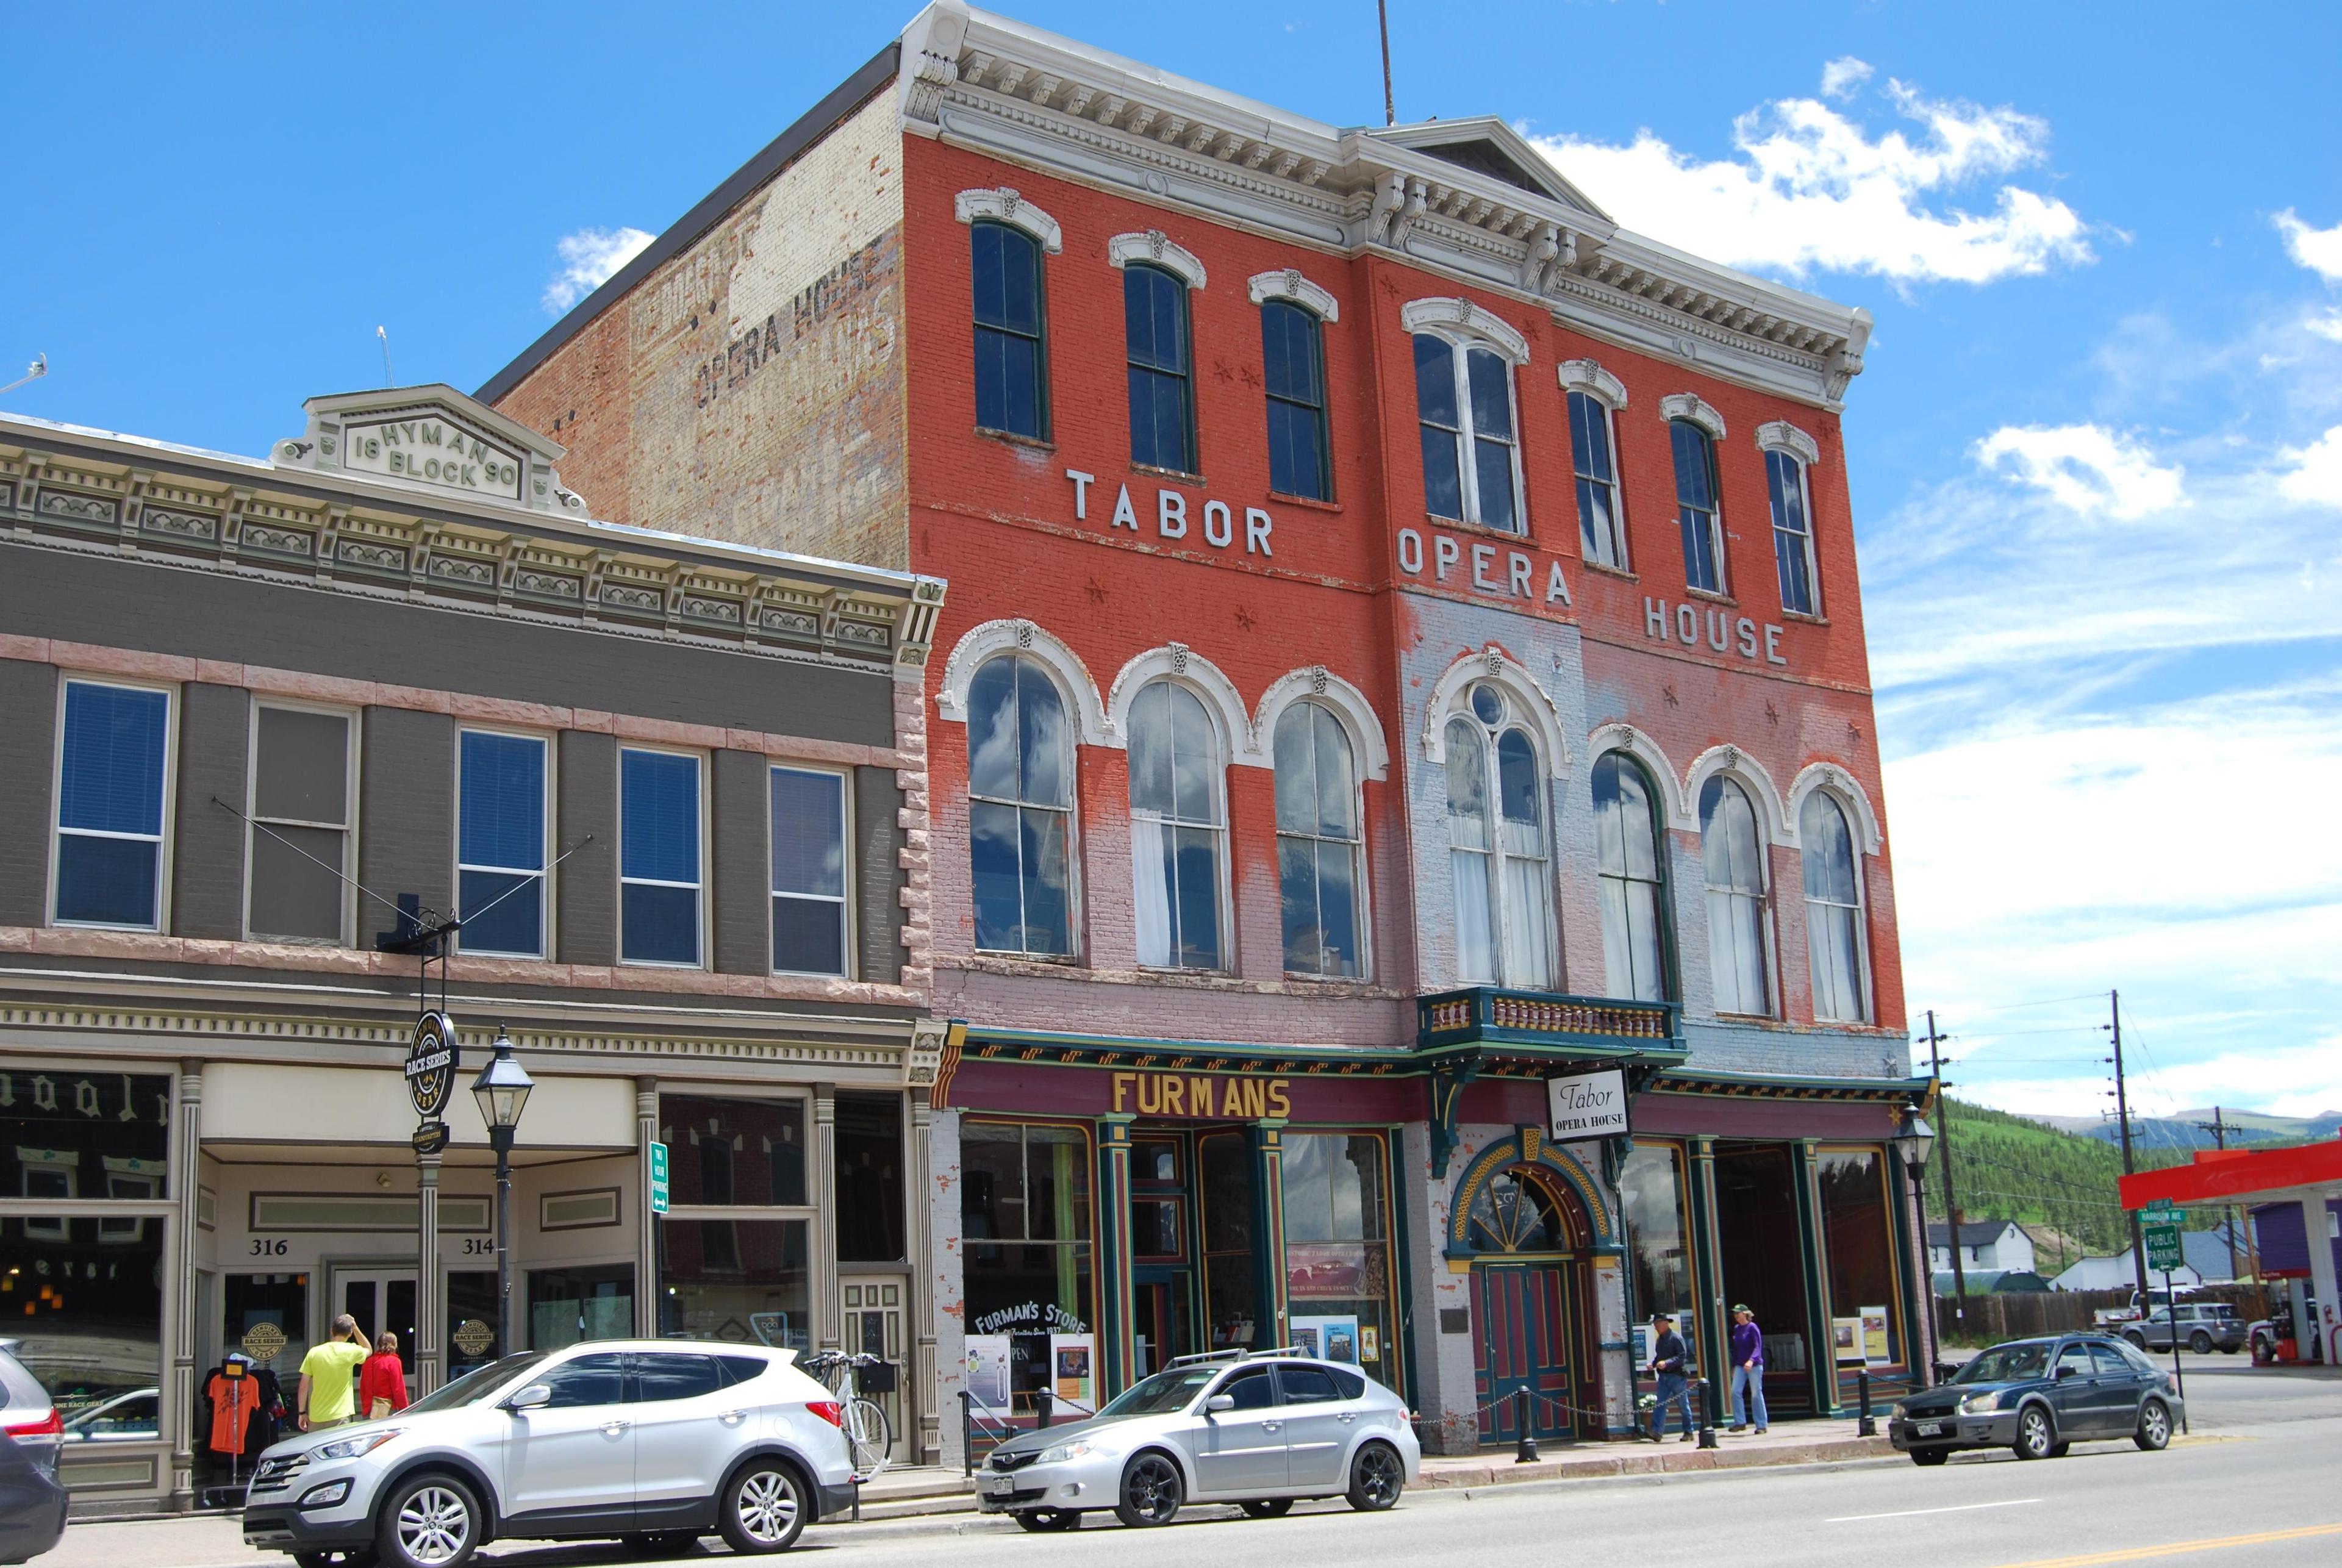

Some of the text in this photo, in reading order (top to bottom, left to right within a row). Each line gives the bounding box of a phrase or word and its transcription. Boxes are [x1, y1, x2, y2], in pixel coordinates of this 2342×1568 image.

[356, 435, 380, 459] 18
[381, 422, 489, 464] HYMAN
[389, 450, 476, 487] BLOCK
[485, 461, 517, 485] 90
[1065, 468, 1787, 665] TABOR OPERA HOUSE
[406, 1049, 451, 1076] RACE SERIES
[417, 1087, 439, 1108] GEAR
[1112, 1072, 1291, 1118] FURMANS
[1560, 1083, 1613, 1110] Tabor
[1555, 1114, 1624, 1131] OPERA HOUSE
[654, 1148, 663, 1161] TWO
[654, 1164, 665, 1177] HOUR
[652, 1180, 667, 1194] PARKING
[2141, 1211, 2182, 1221] HARRISON AVE
[249, 1239, 288, 1256] 316
[462, 1237, 495, 1255] 314
[2147, 1233, 2175, 1247] PUBLIC
[2147, 1248, 2179, 1262] PARKING
[975, 1300, 1087, 1337] FURMAN'S STORE
[252, 1325, 278, 1336] GENUINE
[1047, 1326, 1061, 1335] 1937
[1011, 1347, 1030, 1361] PEN
